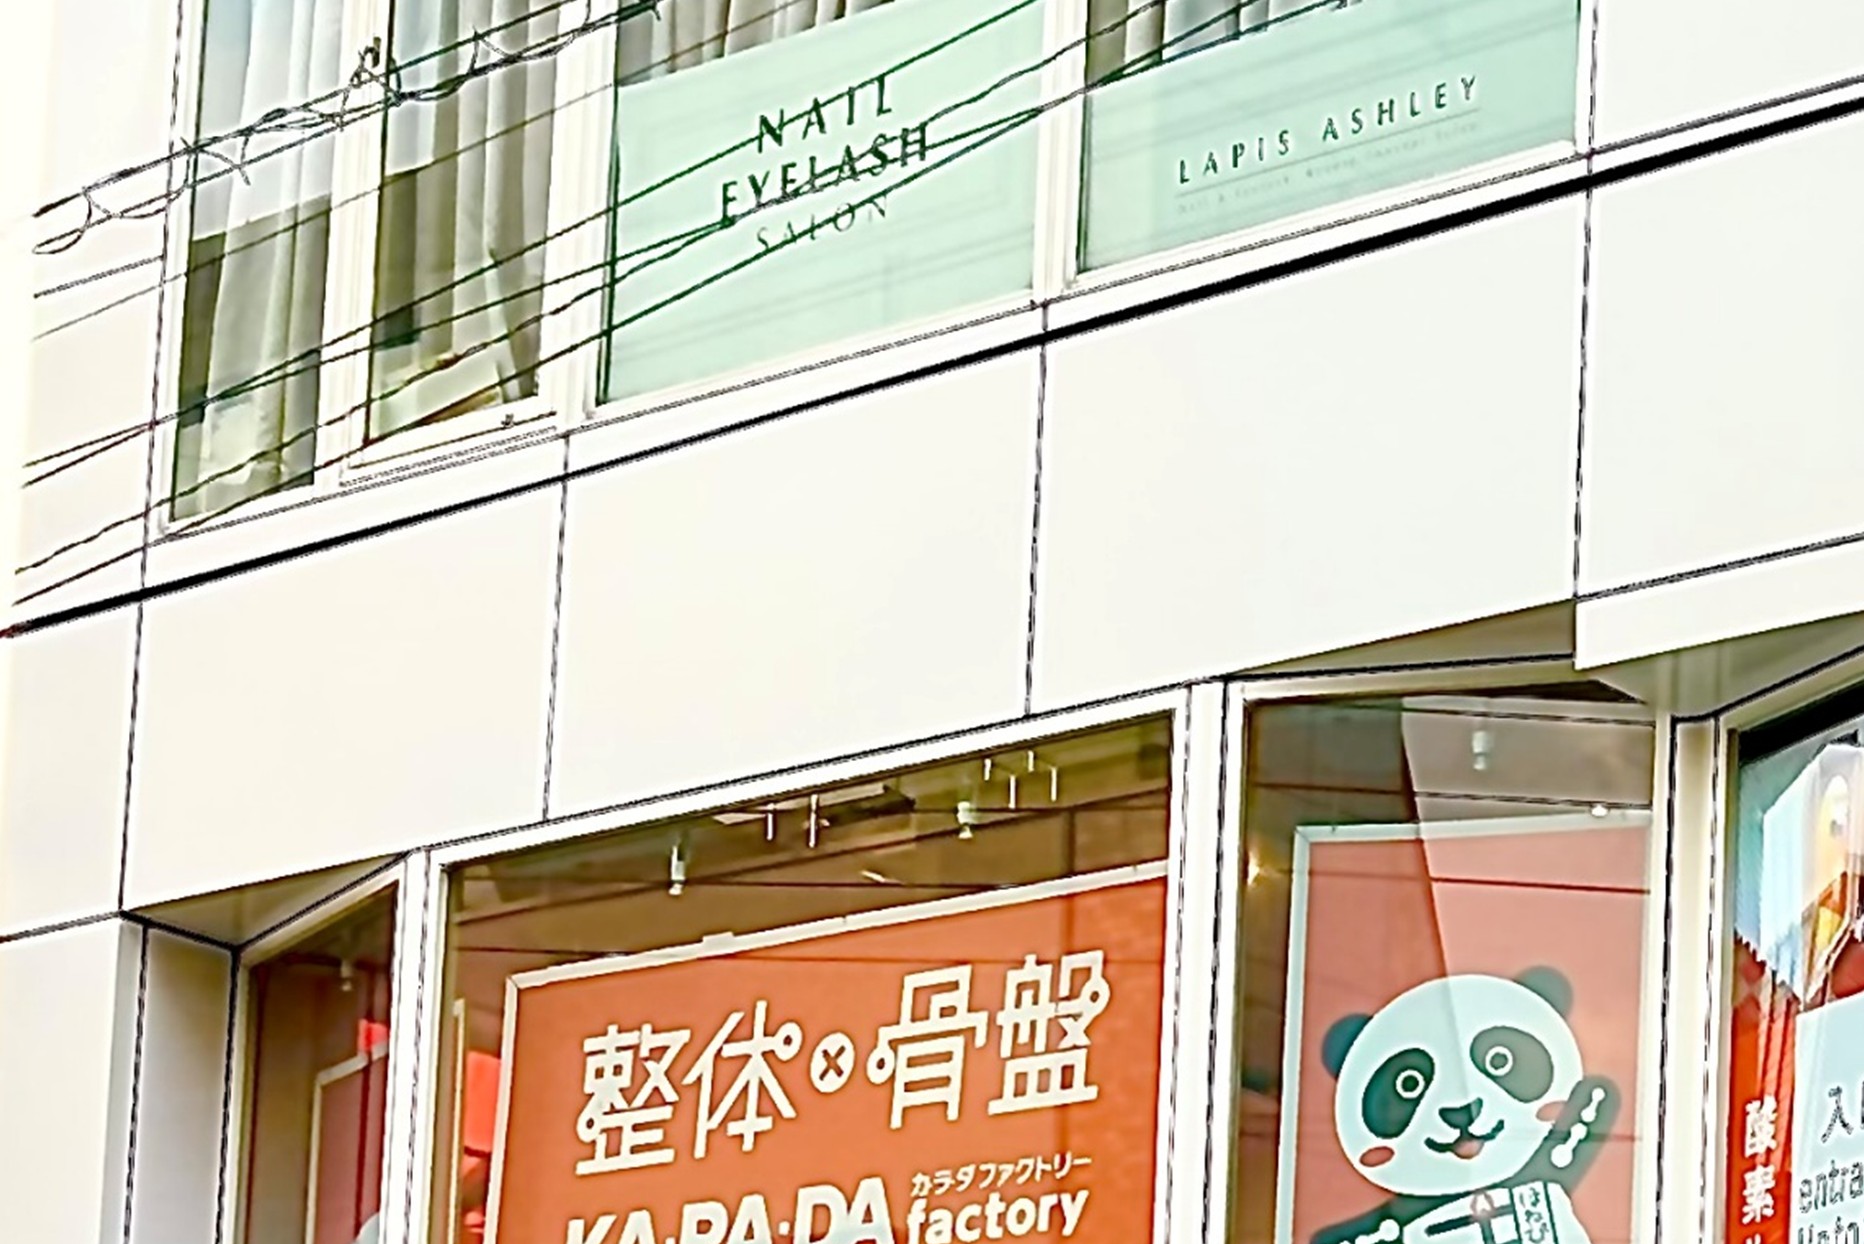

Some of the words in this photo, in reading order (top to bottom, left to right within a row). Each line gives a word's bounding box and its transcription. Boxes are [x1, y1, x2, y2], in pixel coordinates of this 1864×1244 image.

[756, 75, 892, 154] NAIL
[1179, 130, 1290, 184] LAPIS
[1322, 75, 1476, 142] ASHLEY
[722, 121, 927, 225] EYELASH
